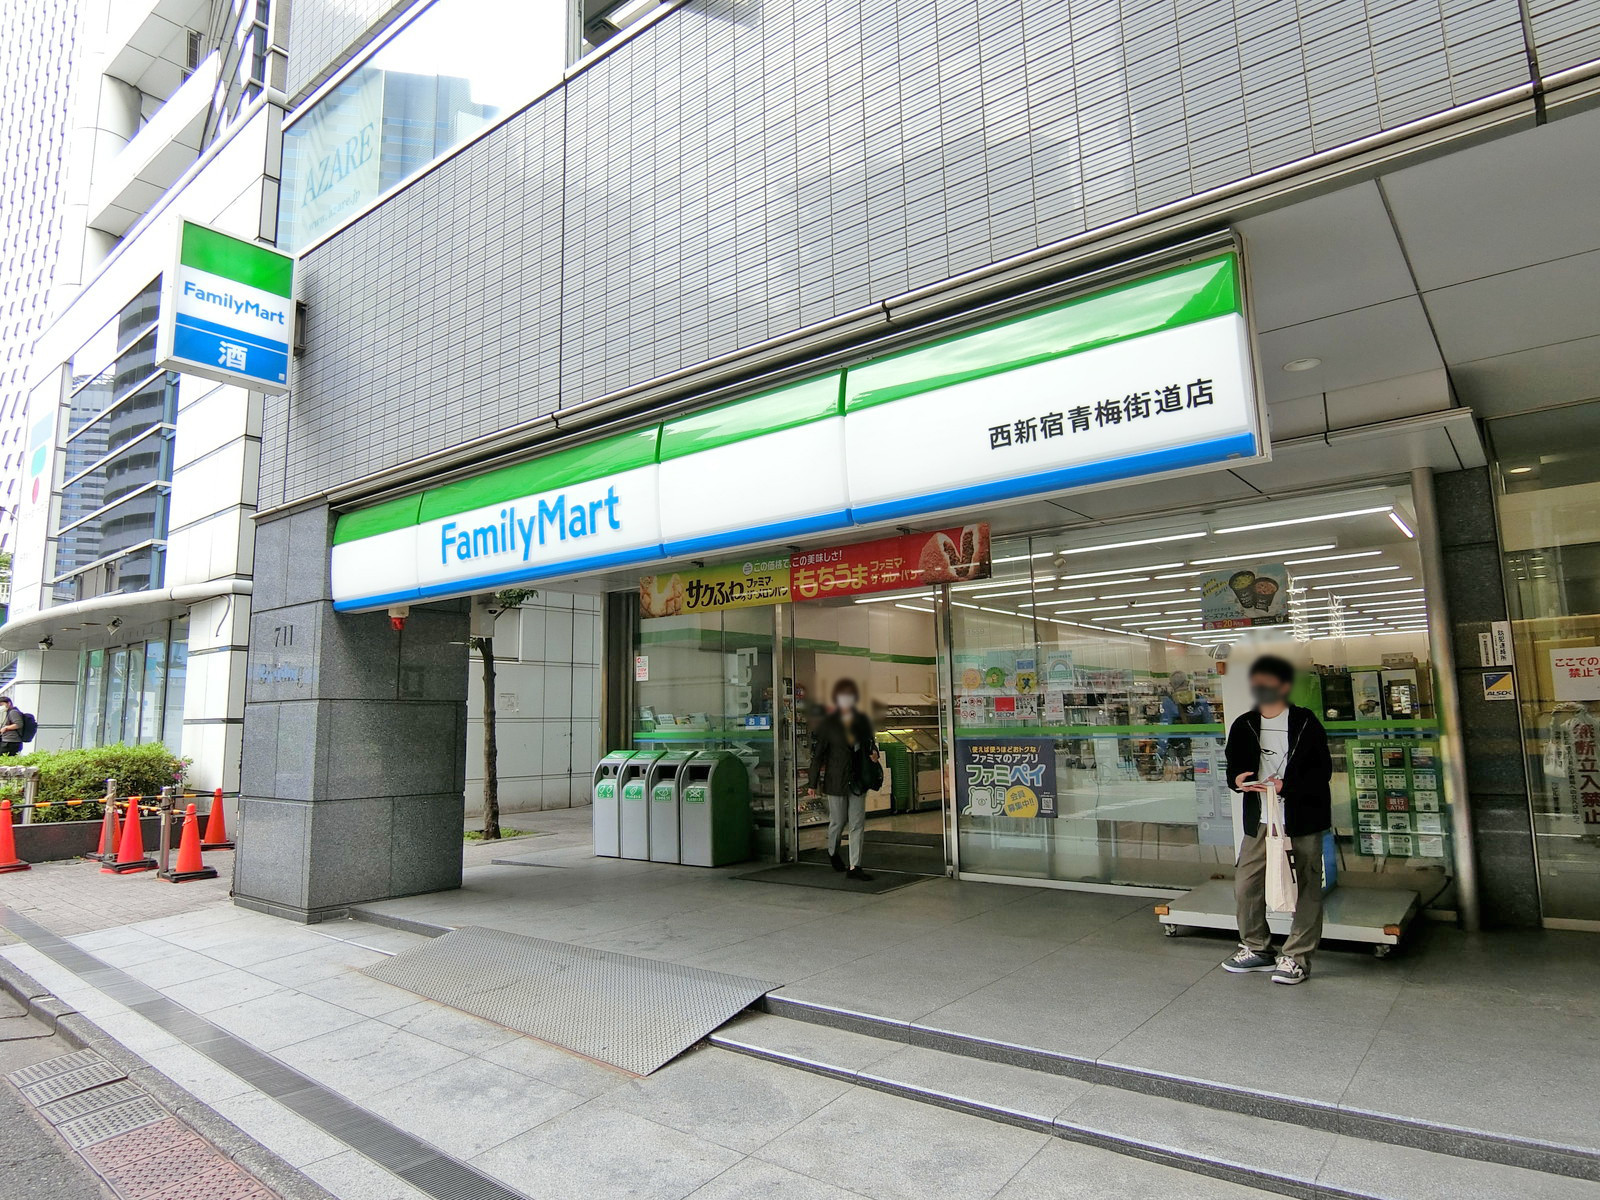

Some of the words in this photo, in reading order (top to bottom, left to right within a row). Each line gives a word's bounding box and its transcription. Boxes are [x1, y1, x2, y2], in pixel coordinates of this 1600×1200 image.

[301, 122, 373, 208] AZARE
[184, 281, 284, 325] FamilyMart
[218, 341, 248, 371] 酒
[988, 378, 1214, 450] 西新宿青梅街道店
[442, 485, 620, 564] FamilyMart
[794, 563, 868, 598] もちうま
[275, 625, 293, 648] 711
[1555, 657, 1600, 668] ここでの
[972, 754, 1038, 763] ファミマのアプリ
[966, 764, 1046, 786] ファミペイ
